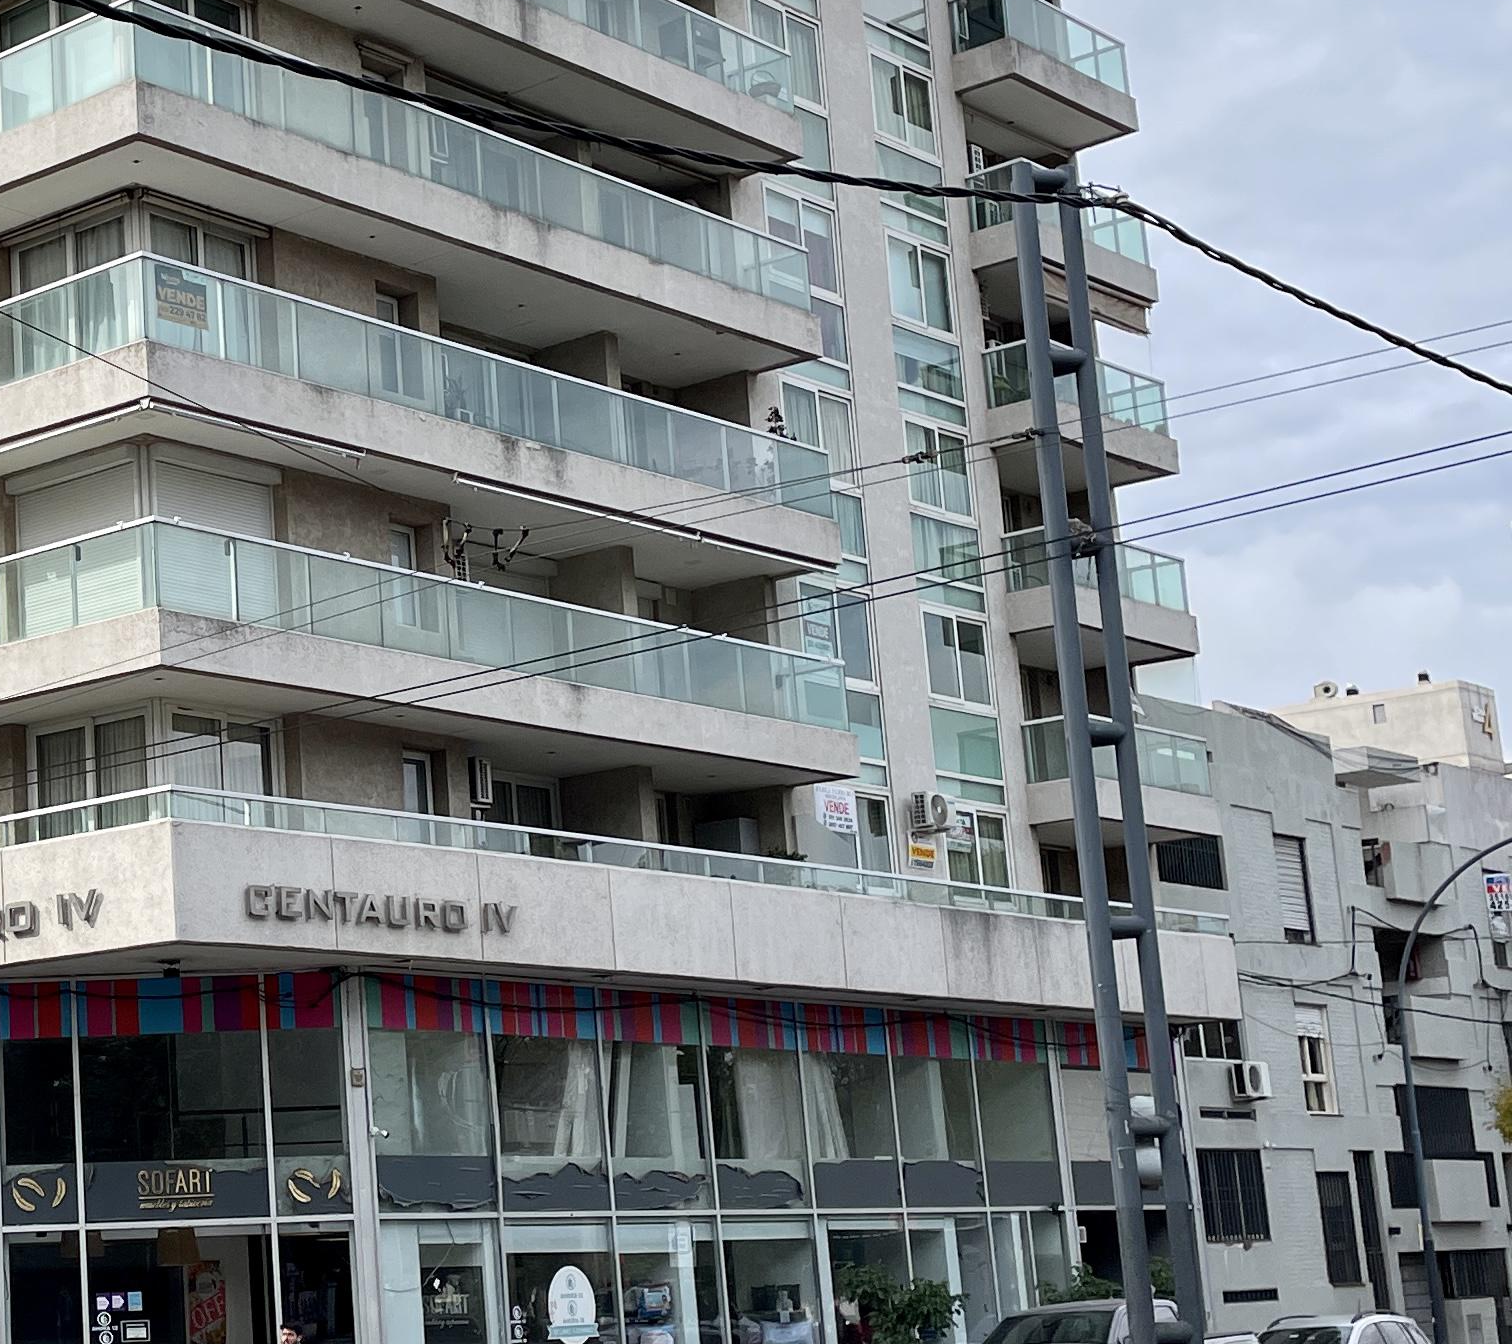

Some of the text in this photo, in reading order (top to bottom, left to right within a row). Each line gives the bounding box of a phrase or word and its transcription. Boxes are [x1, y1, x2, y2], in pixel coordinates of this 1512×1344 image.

[157, 286, 205, 310] VENDE
[823, 798, 851, 816] VENDE
[55, 888, 105, 932] IV
[245, 883, 517, 935] CENTAURO IV
[191, 1295, 226, 1329] OFF
